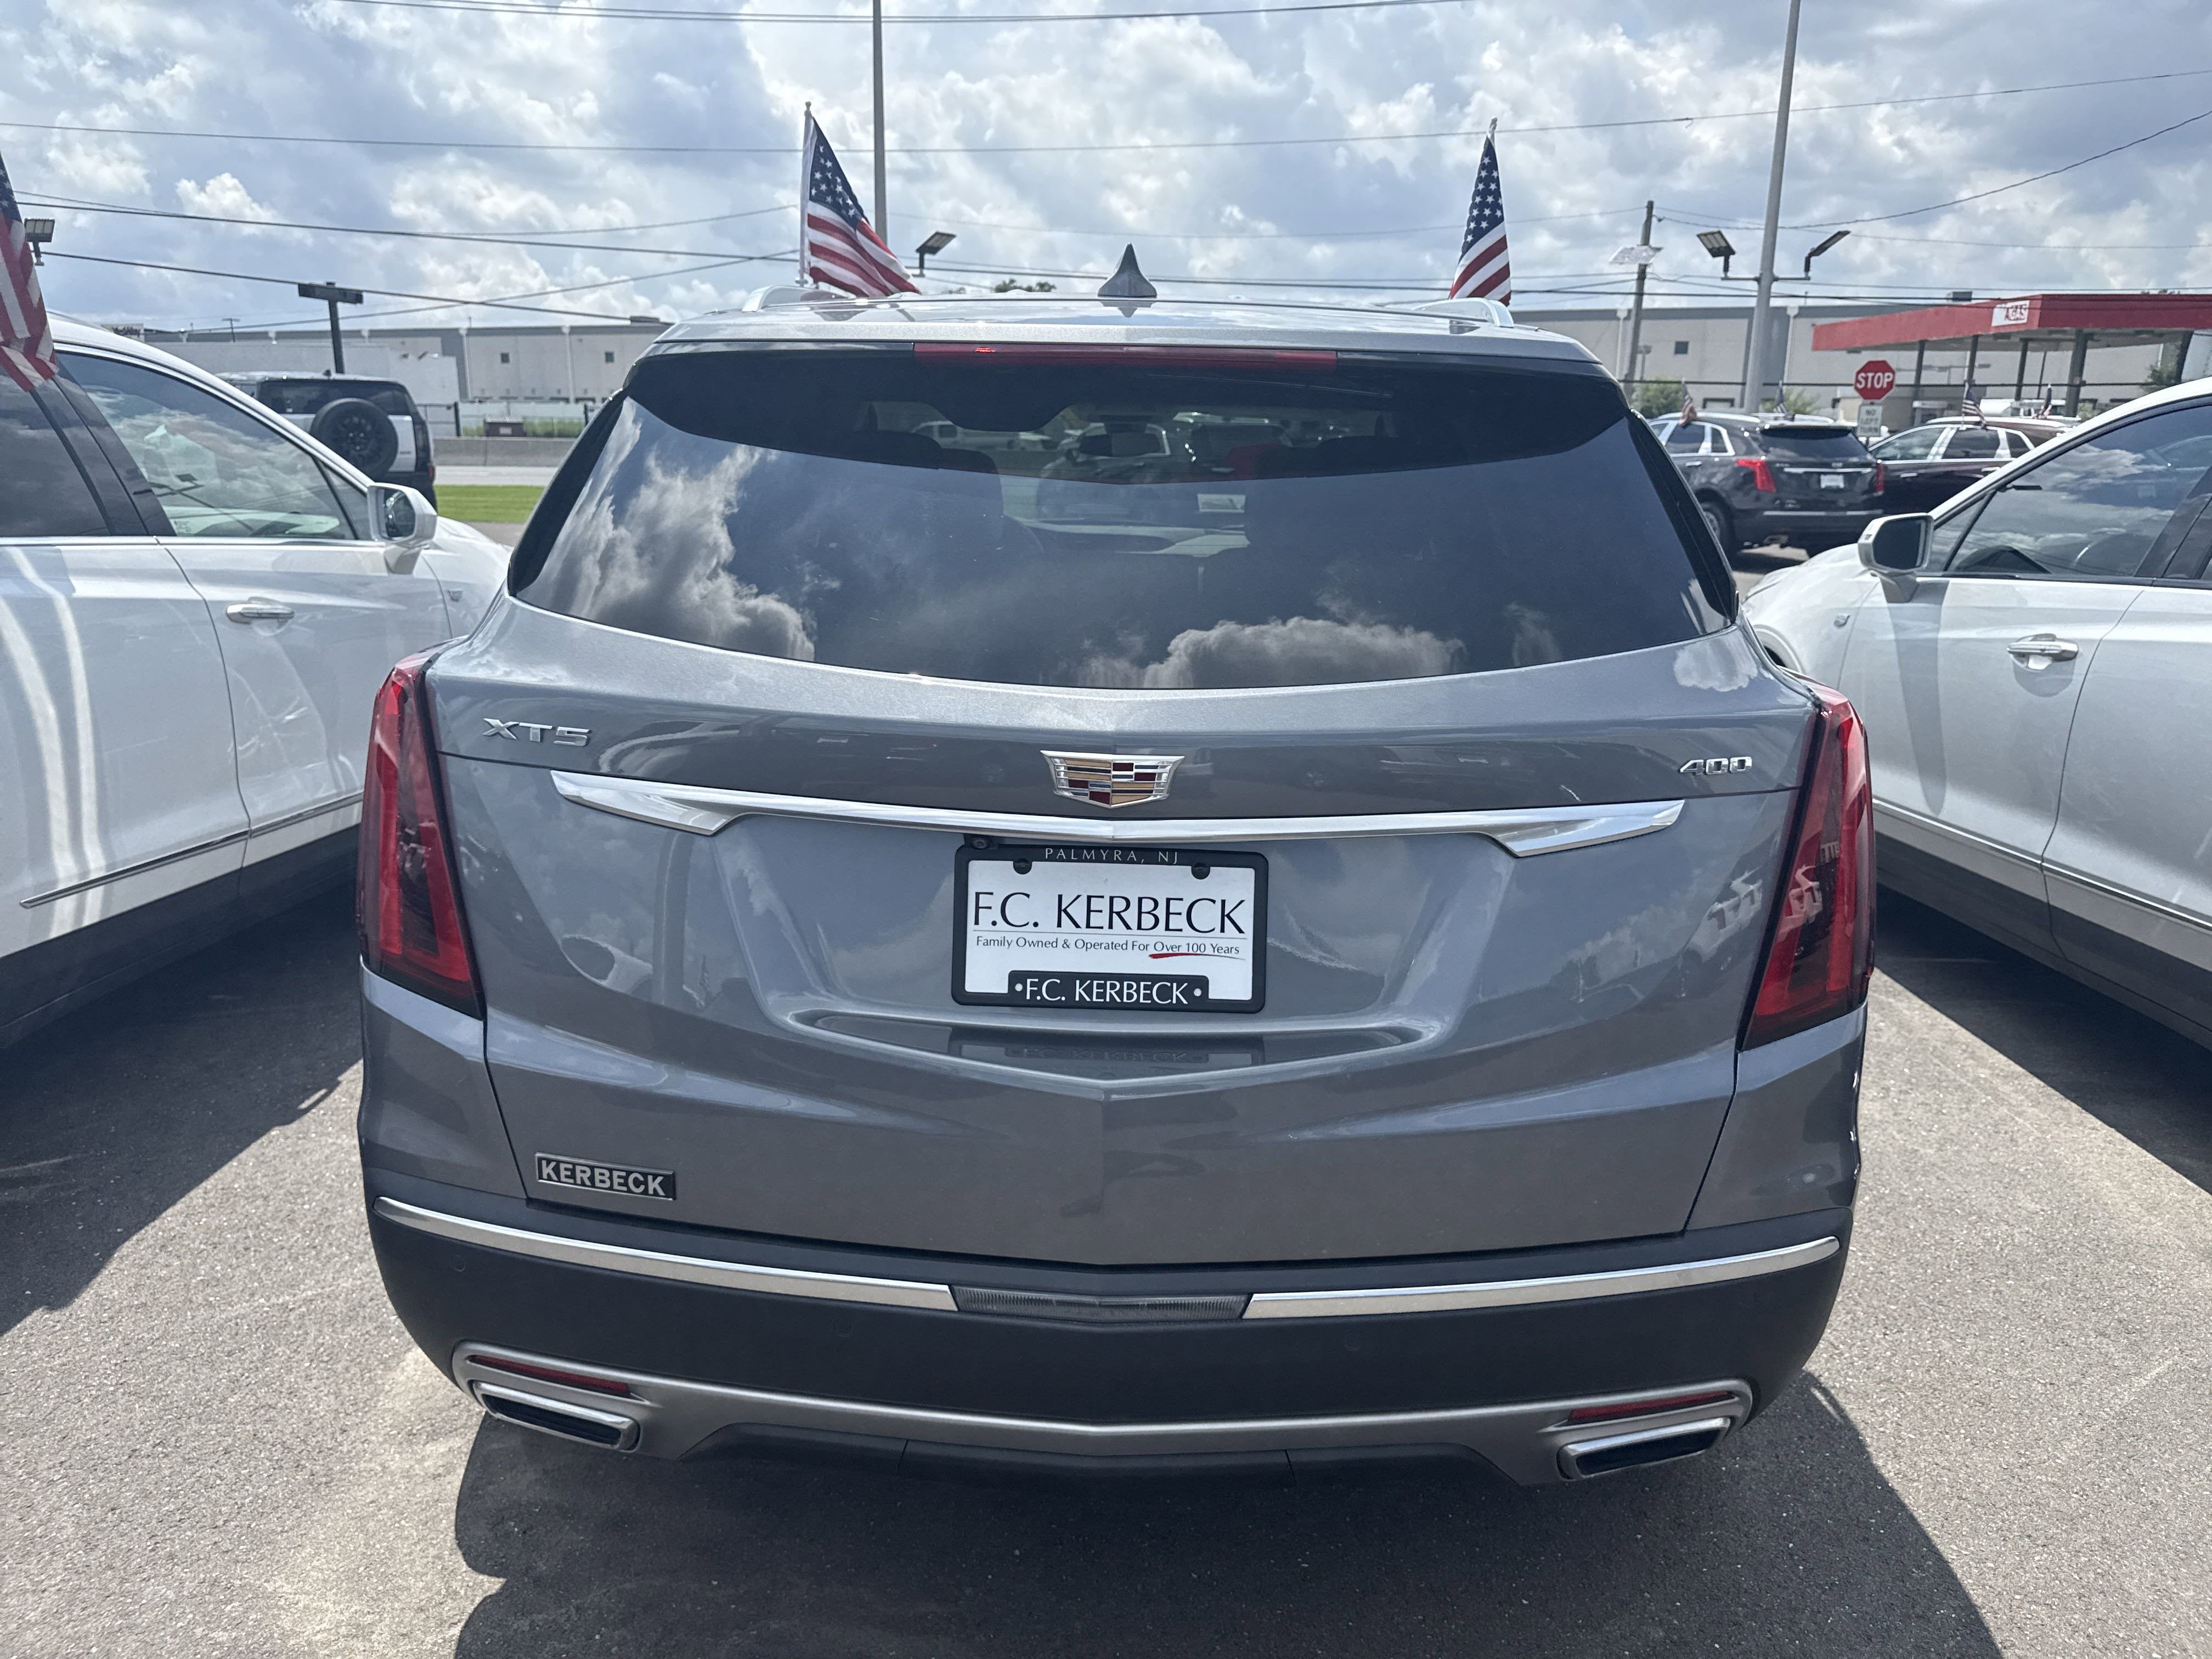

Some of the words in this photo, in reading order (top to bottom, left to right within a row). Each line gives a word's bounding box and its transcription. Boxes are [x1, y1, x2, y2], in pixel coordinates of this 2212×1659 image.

[1856, 372, 1893, 389] STOP
[482, 718, 590, 747] XT5
[1679, 755, 1753, 776] 400
[1045, 847, 1145, 864] PALMYRA,
[1158, 850, 1178, 865] NJ
[973, 891, 1039, 928] F.C.
[1057, 894, 1246, 934] KERBECK
[976, 935, 1013, 949] Family
[1015, 936, 1058, 948] Owned
[1062, 938, 1070, 949] &
[1074, 938, 1128, 952] Operated
[1131, 940, 1150, 951] For
[1153, 941, 1182, 952] Over
[1186, 942, 1206, 953] 100
[1210, 943, 1240, 955] Years
[1025, 978, 1065, 1001] F.C.
[1075, 979, 1189, 1005] KERBECK
[541, 1159, 665, 1197] KERBECK
